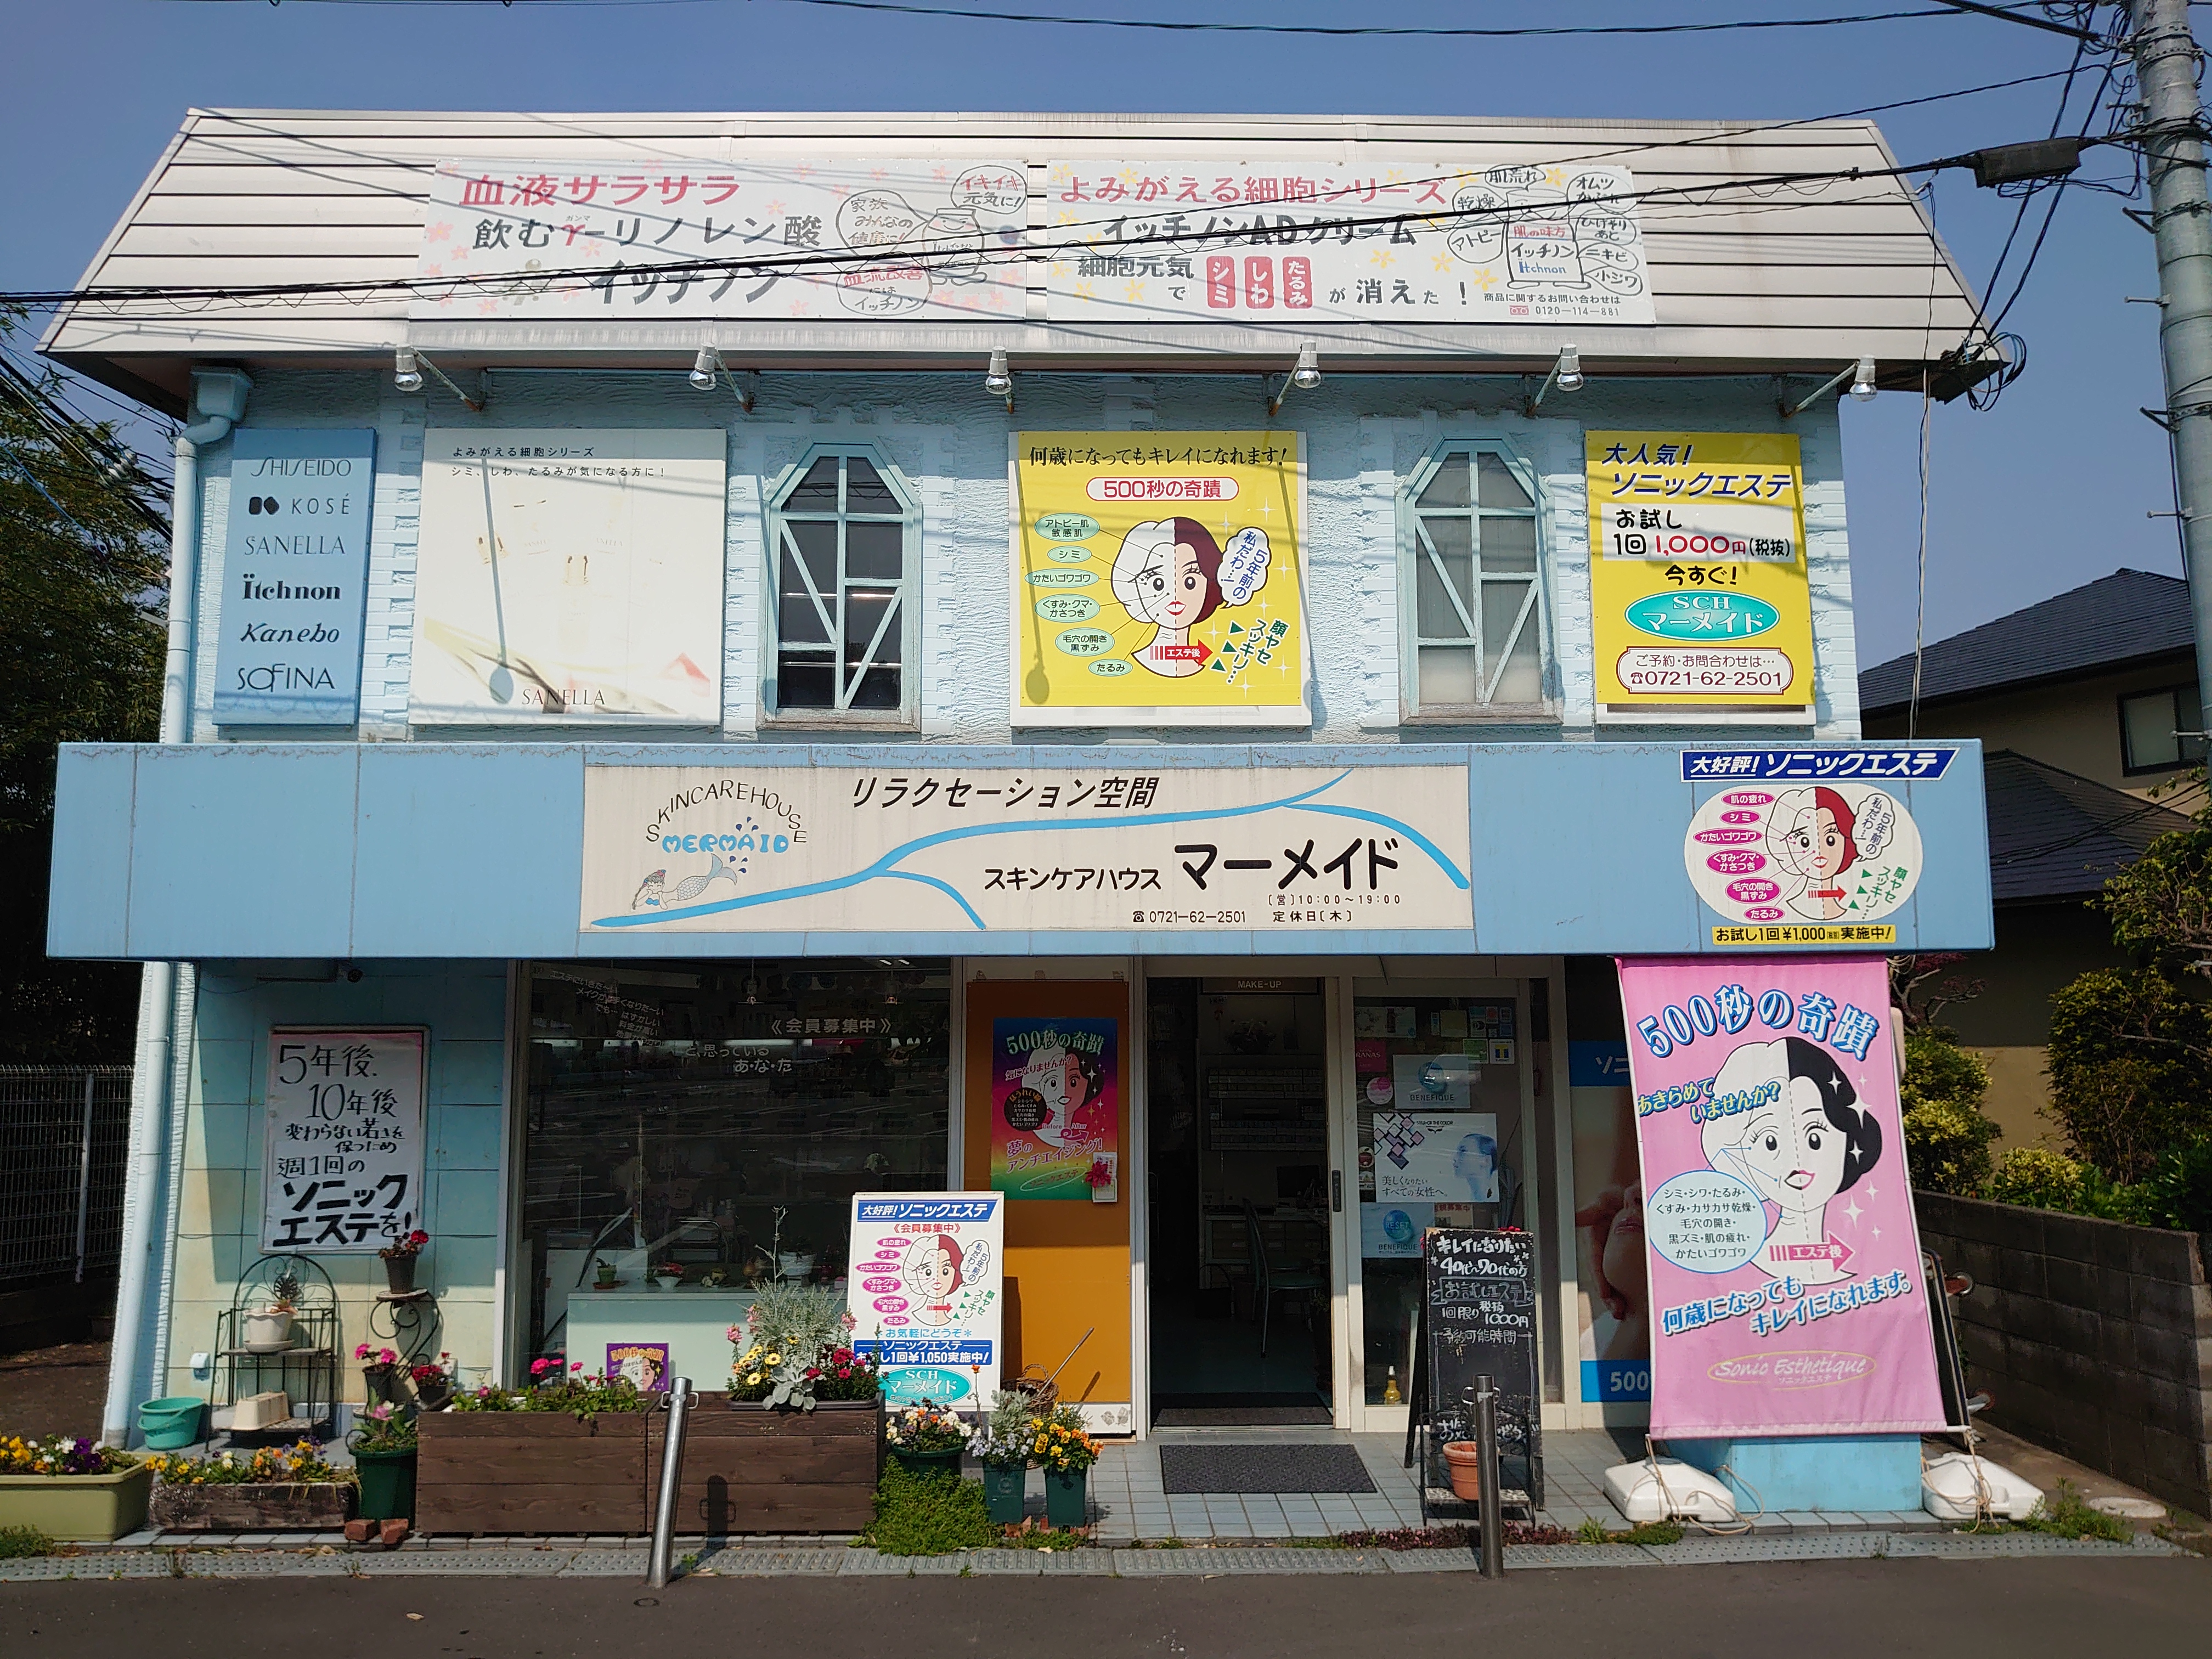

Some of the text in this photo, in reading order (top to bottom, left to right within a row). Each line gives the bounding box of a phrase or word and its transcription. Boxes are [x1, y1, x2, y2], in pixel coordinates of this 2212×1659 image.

[960, 173, 1022, 192] イキイキ
[1489, 167, 1537, 184] 肌荒れ
[1576, 176, 1615, 190] オムツ
[459, 174, 740, 207] 血液サラサラ
[1060, 175, 1447, 204] よみがえる細胞シリーズ
[851, 198, 889, 213] 家族
[963, 192, 1022, 207] 元気に!
[1457, 194, 1496, 211] 乾燥
[854, 215, 914, 229] みんなの
[1103, 214, 1417, 246] イッチノンADクリーム
[1581, 218, 1627, 231] ひげそり
[848, 232, 904, 246] 健康に!
[1452, 228, 1502, 251] アトピー
[1513, 225, 1566, 238] 肌の味方
[1594, 229, 1620, 241] あと
[1511, 242, 1575, 258] イッチノン
[1584, 247, 1629, 263] ニキビ
[844, 265, 923, 287] 血流改善
[1078, 256, 1195, 279] 細胞元気
[1168, 287, 1187, 301] で
[1212, 261, 1230, 305] シミ
[1251, 262, 1270, 304] しわ
[1288, 261, 1308, 306] たるみ
[1329, 289, 1346, 304] が
[1595, 270, 1638, 286] 小ジワ
[854, 296, 922, 311] イッチノン
[1483, 293, 1621, 304] 商品に関するお問い合わせは
[453, 446, 595, 458] よみがえる細胞シリーズ
[1030, 447, 1288, 466] 何歳になってもキレイになれます!
[1601, 442, 1694, 466] 大人気!
[251, 456, 352, 477] SHISEIDO
[1103, 479, 1222, 499] 500秒の奇蹟
[1612, 472, 1792, 498] ソニックエステ
[291, 493, 349, 515] KOSÉ
[1045, 518, 1090, 529] アトピー肌
[1616, 509, 1683, 529] お試し
[1051, 528, 1083, 538] 敏感肌
[244, 535, 346, 555] SANELLA
[1058, 550, 1081, 559] シミ
[1032, 573, 1091, 583] かたいゴワゴワ
[1232, 549, 1268, 600] 5年前の
[1664, 565, 1737, 586] 今すぐ!
[1673, 596, 1732, 610] SCH
[1049, 608, 1086, 618] かさつき
[1642, 612, 1764, 633] マーメイド
[240, 623, 340, 643] Kanebo
[1062, 634, 1107, 644] 毛穴の開き
[1070, 644, 1100, 652] 黒ずみ
[1256, 619, 1289, 665] 顔ヤセ
[1166, 648, 1201, 658] エステ後
[1096, 663, 1126, 673] たるみ
[238, 663, 335, 692] SOFINA
[1645, 671, 1781, 687] 0721-62-2501
[522, 689, 606, 706] SANELLA
[1690, 753, 1938, 777] 大好評! ソニックエステ
[853, 776, 1159, 809] リラクセーション空間
[1731, 794, 1767, 804] 肌の疲れ
[646, 779, 807, 843] SKINCAREHOUSE
[1730, 814, 1751, 822] シミ
[1700, 831, 1757, 841] かたいゴワゴワ
[1865, 812, 1893, 855] 5年前の
[662, 834, 789, 854] MERMAID
[984, 838, 1398, 890] スキンケアハウス マーメイド
[1719, 861, 1756, 871] かさつき
[1732, 882, 1773, 892] 毛穴の開き
[1884, 866, 1909, 904] 顔ヤセ
[1740, 891, 1767, 900] 黒ずみ
[1149, 911, 1246, 923] 0721-62-2501
[1750, 909, 1779, 919] たるみ
[1638, 984, 1878, 1060] 500秒の奇蹟
[1006, 1030, 1105, 1056] 500秒の奇蹟
[1005, 1056, 1072, 1081] 気になりませんか?
[306, 1083, 398, 1121] 10年後
[1637, 1077, 1715, 1116] あきらめて
[1690, 1082, 1781, 1123] いませんか?
[285, 1118, 406, 1142] 変わらない若さを
[335, 1140, 397, 1153] 保つため
[1007, 1139, 1033, 1158] 夢の
[1007, 1137, 1103, 1174] アンチエイジング!
[276, 1155, 365, 1178] 週1回の
[1382, 1175, 1428, 1186] 美しくなりたい
[283, 1175, 408, 1212] ソニック
[1382, 1188, 1448, 1197] すべての女性へ。
[862, 1203, 988, 1218] 大好評! ソニックエステ
[1385, 1221, 1409, 1229] RESET
[1436, 1235, 1526, 1255] キレイになりたい
[1675, 1248, 1747, 1259] かたいゴワゴワ
[1792, 1245, 1844, 1259] エステ後
[1445, 1281, 1523, 1300] お試しエステ
[976, 1290, 996, 1316] 顔ヤセ
[1479, 1300, 1504, 1313] 税抜
[1662, 1276, 1804, 1336] 何歳になっても
[1750, 1270, 1912, 1336] キレイになれます。
[1442, 1306, 1480, 1320] 1回限り
[1442, 1328, 1516, 1345] 予約可能時間
[884, 1341, 963, 1351] ソニックエステ
[856, 1351, 990, 1364] おし1回¥1,050実施中!
[905, 1370, 939, 1379] SCH
[890, 1380, 957, 1394] マーメイド
